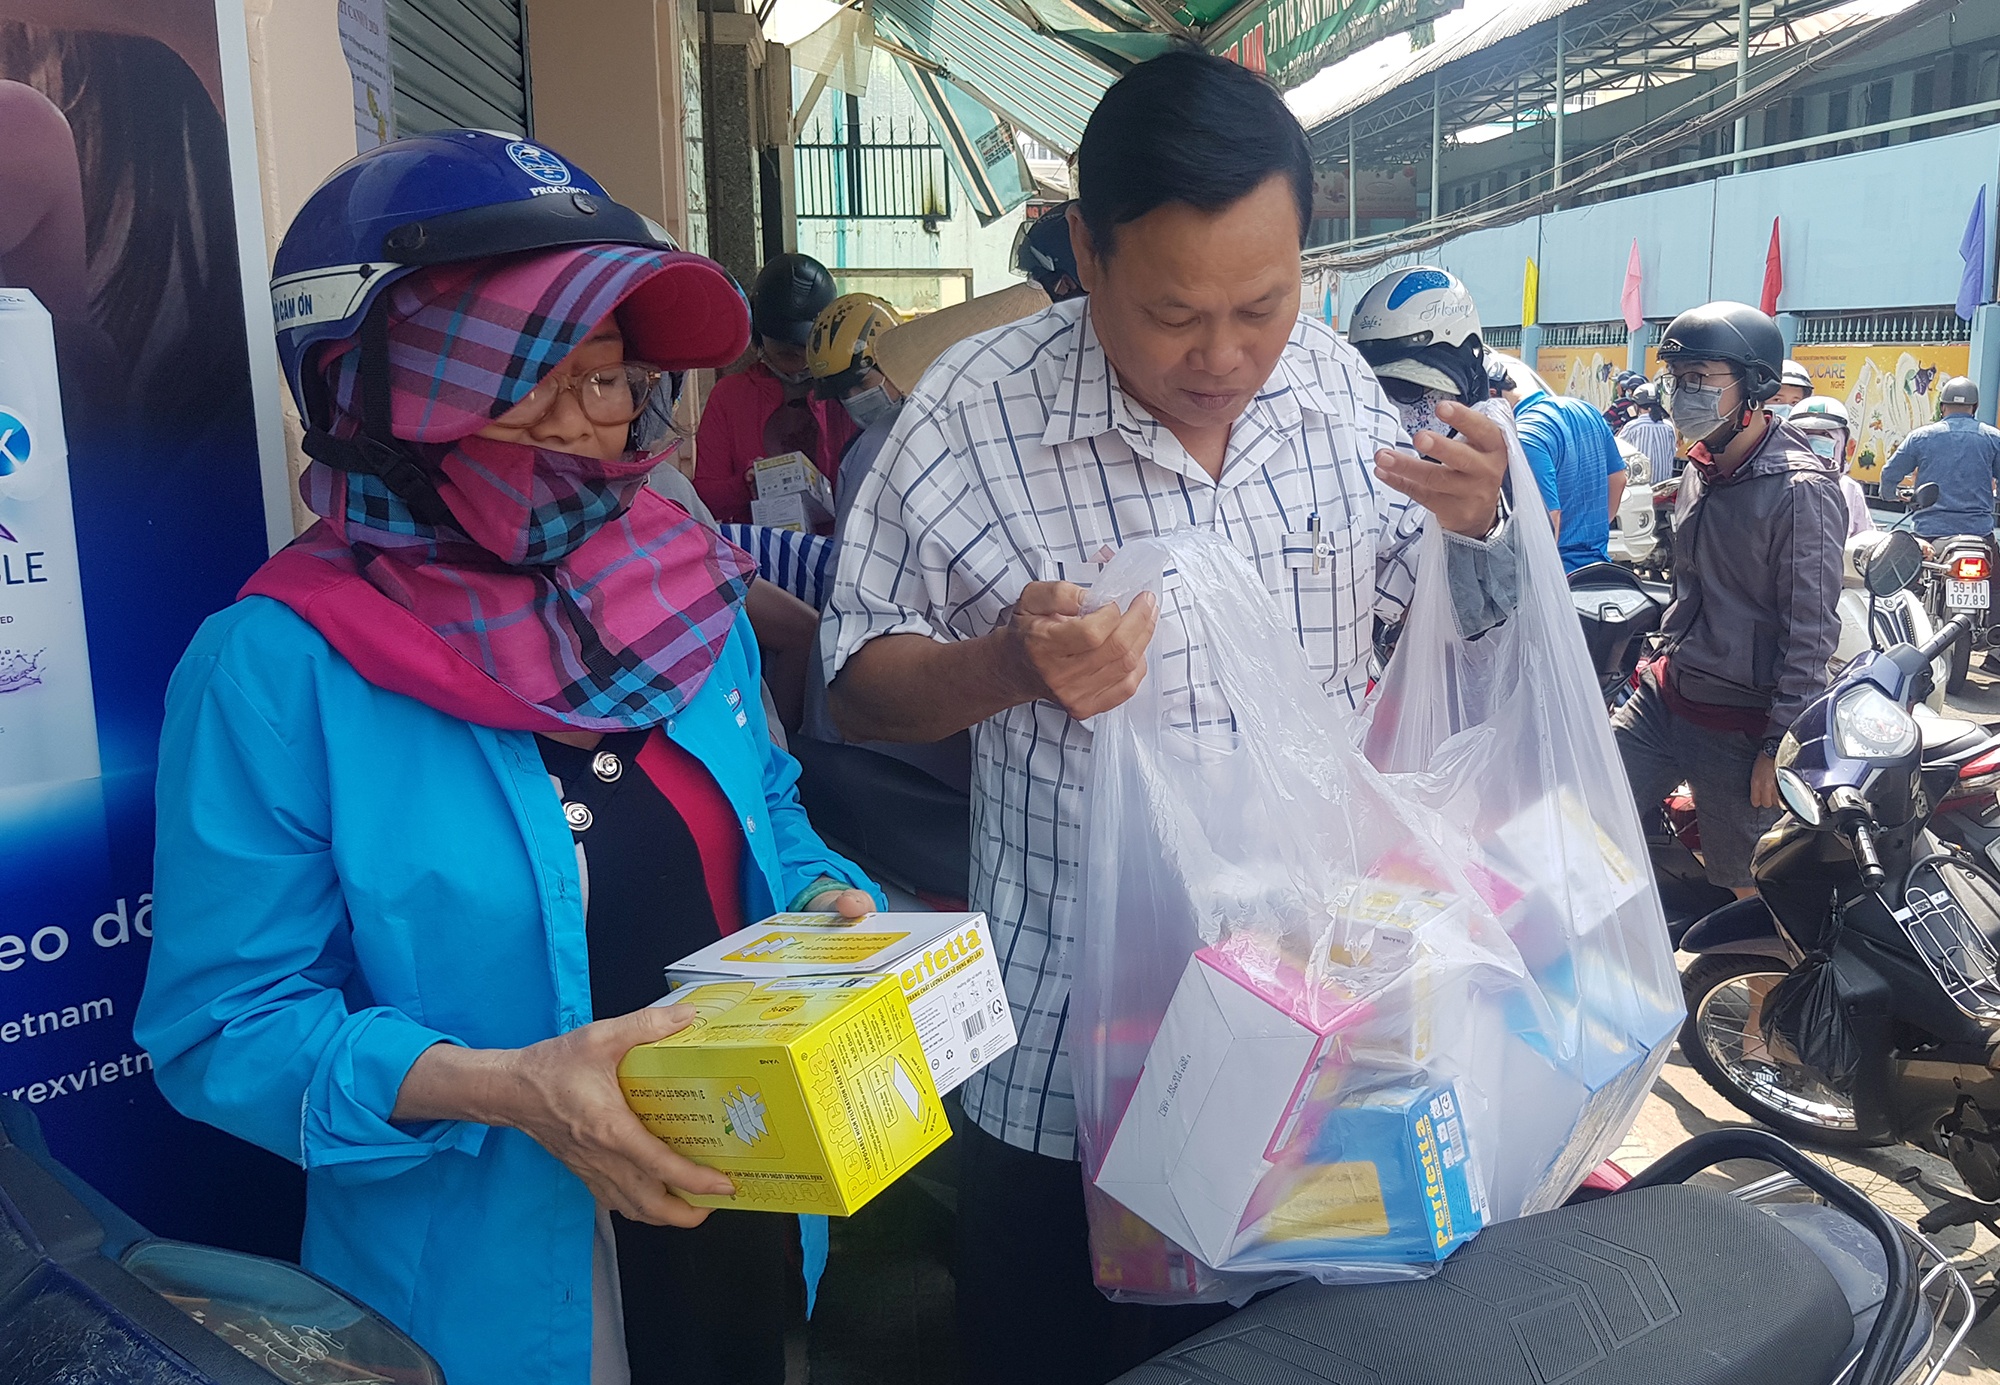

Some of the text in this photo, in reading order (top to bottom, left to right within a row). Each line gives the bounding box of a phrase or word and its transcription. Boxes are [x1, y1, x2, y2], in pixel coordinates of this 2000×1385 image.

[1950, 593, 1986, 606] 167.89
[1981, 803, 1998, 817] HONDA
[0, 997, 114, 1044] etnam
[808, 1047, 871, 1202] Perfetta
[830, 1058, 871, 1170] DISPOSABLE HIGH FILTRATION FACE MASK
[1415, 1115, 1449, 1249] Perfetta
